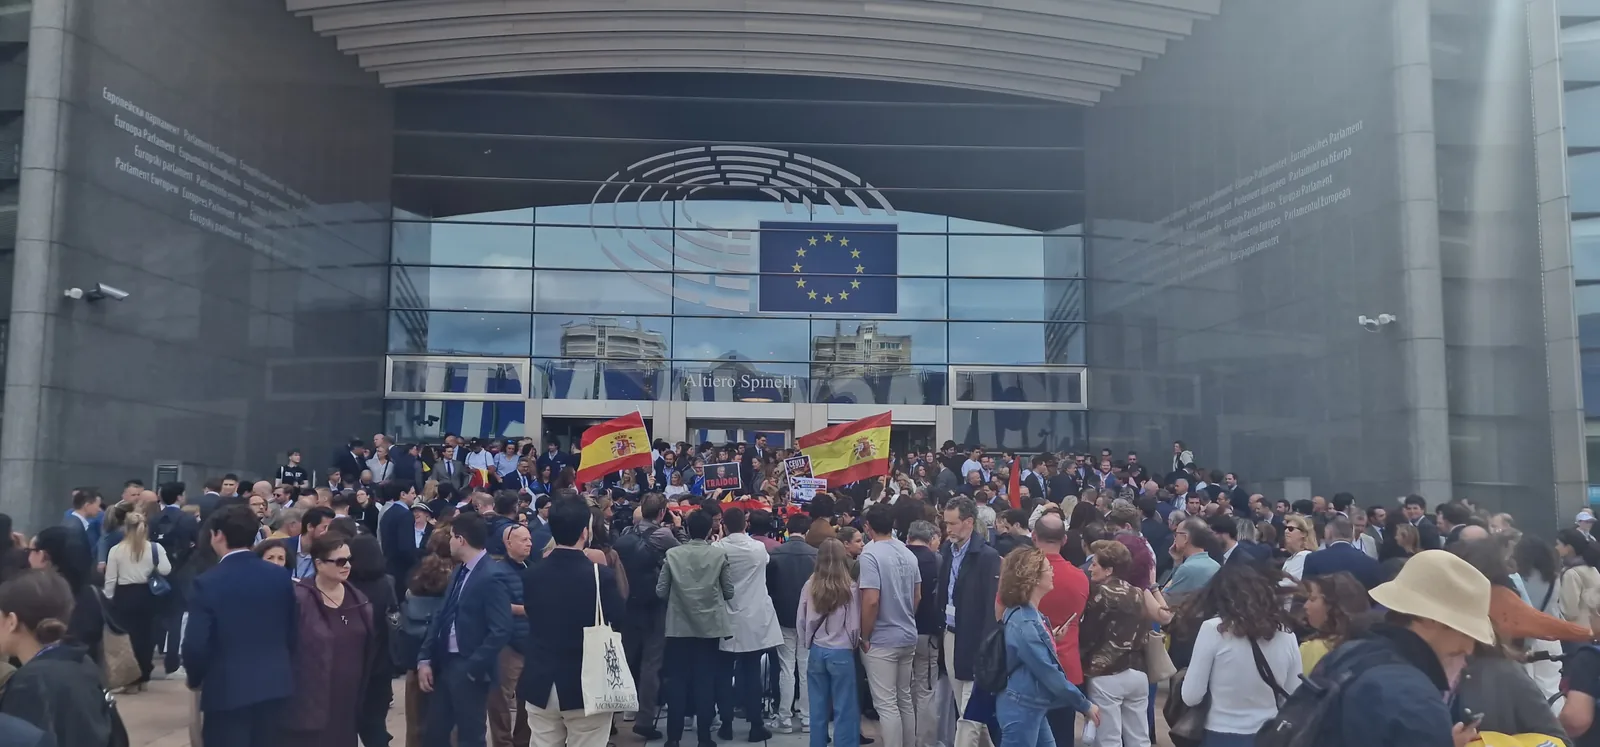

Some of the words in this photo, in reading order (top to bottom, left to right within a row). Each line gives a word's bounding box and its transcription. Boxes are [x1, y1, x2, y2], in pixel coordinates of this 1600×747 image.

[114, 114, 142, 138] Euroopa
[142, 128, 176, 154] Parlament
[1329, 120, 1363, 144] Parlament
[134, 145, 161, 167] Europski
[162, 160, 193, 182] parlament
[1320, 157, 1329, 168] na
[1329, 146, 1352, 164] hEorpa
[115, 156, 150, 182] Parlament
[1301, 174, 1332, 197] Parlament
[1320, 186, 1351, 208] European
[684, 374, 736, 388] Altiero
[741, 375, 797, 392] Spinelli
[788, 458, 806, 468] CEUTA
[706, 477, 738, 487] TRAIDOR
